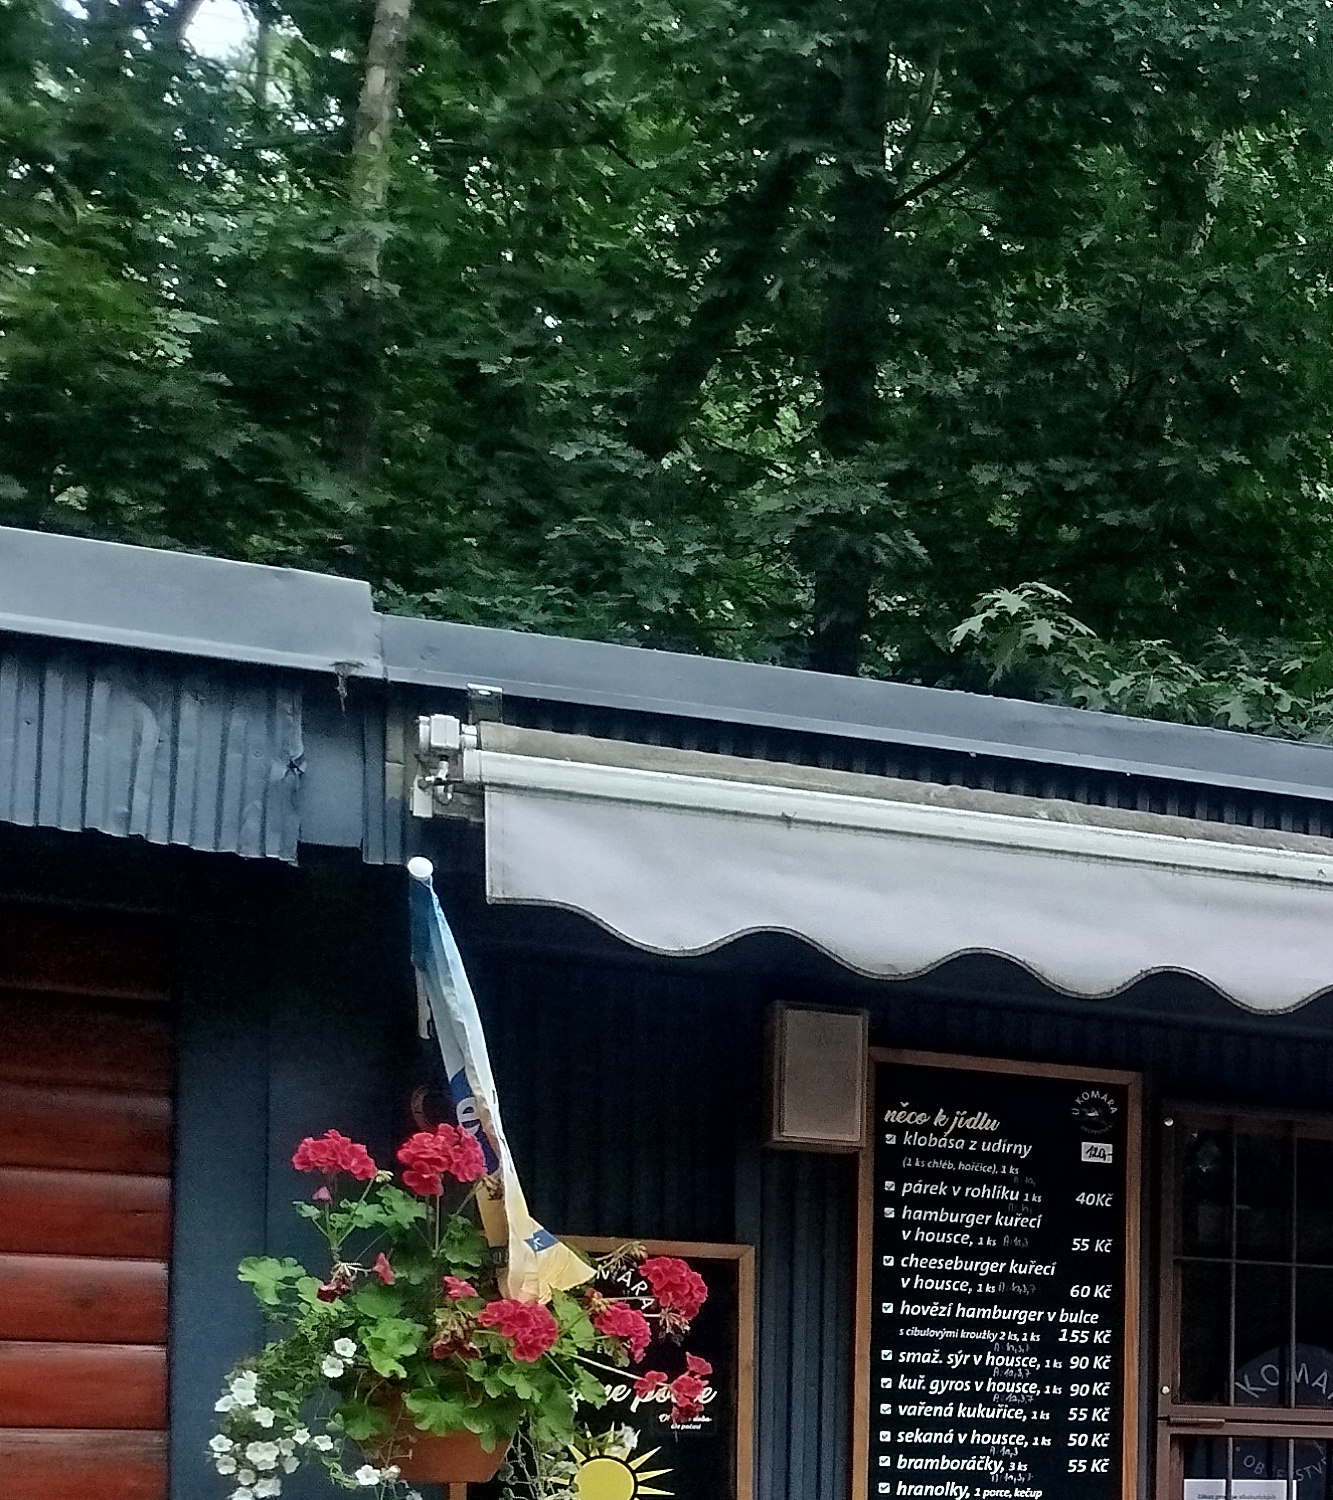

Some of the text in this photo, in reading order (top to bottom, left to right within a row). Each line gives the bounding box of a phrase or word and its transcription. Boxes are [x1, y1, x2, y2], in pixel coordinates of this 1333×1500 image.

[884, 1101, 931, 1125] něco
[933, 1108, 949, 1126] k
[903, 1131, 1032, 1159] klobása z udírny
[901, 1180, 948, 1197] párek
[952, 1186, 961, 1196] v
[965, 1184, 1019, 1201] rohlíku
[902, 1205, 992, 1228] hamburger
[995, 1211, 1042, 1228] kuřecí
[914, 1227, 1113, 1253] housce, 55 Kč
[901, 1253, 1057, 1276] cheeseburger kuřecí
[913, 1274, 1112, 1298] housce, 60 Kč
[900, 1300, 1099, 1325] hovězí hamburger bulce
[906, 1327, 1112, 1344] cibulovými kroužky 155 Kč
[898, 1351, 1041, 1370] smaž. sýr housce,
[898, 1374, 1111, 1397] kuř. gyros housce, 90 Kč
[898, 1401, 1110, 1422] vařená kukuřice, 55 Kč
[896, 1428, 1110, 1448] sekaná housce, 50 Kč
[897, 1454, 1110, 1475] bramboráčky, 55 Kč
[896, 1481, 1043, 1500] hranolky, porce, kečup
